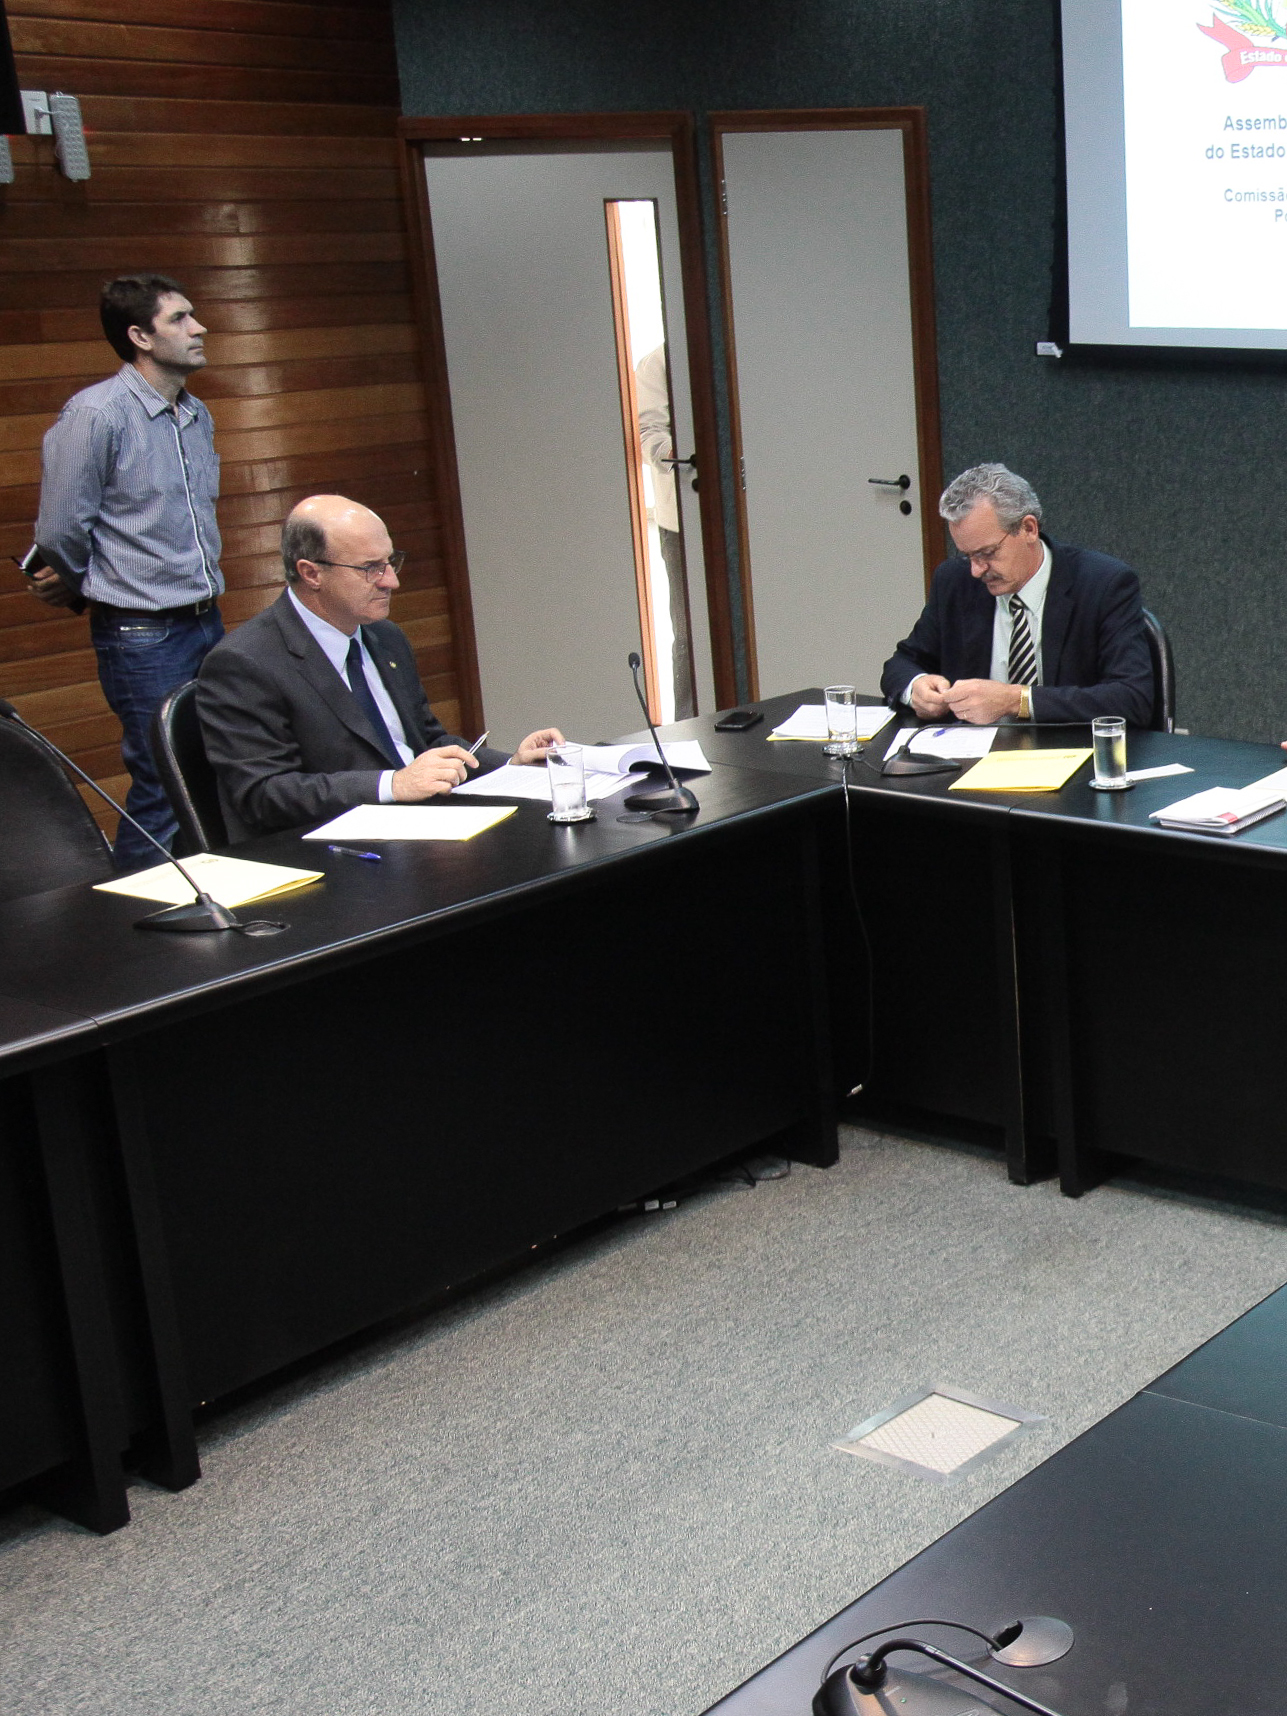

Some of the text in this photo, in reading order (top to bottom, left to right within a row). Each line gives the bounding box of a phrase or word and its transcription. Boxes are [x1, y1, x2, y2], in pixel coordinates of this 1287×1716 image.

[1240, 51, 1281, 65] Estado
[1205, 144, 1225, 159] do
[1230, 143, 1286, 159] Estado
